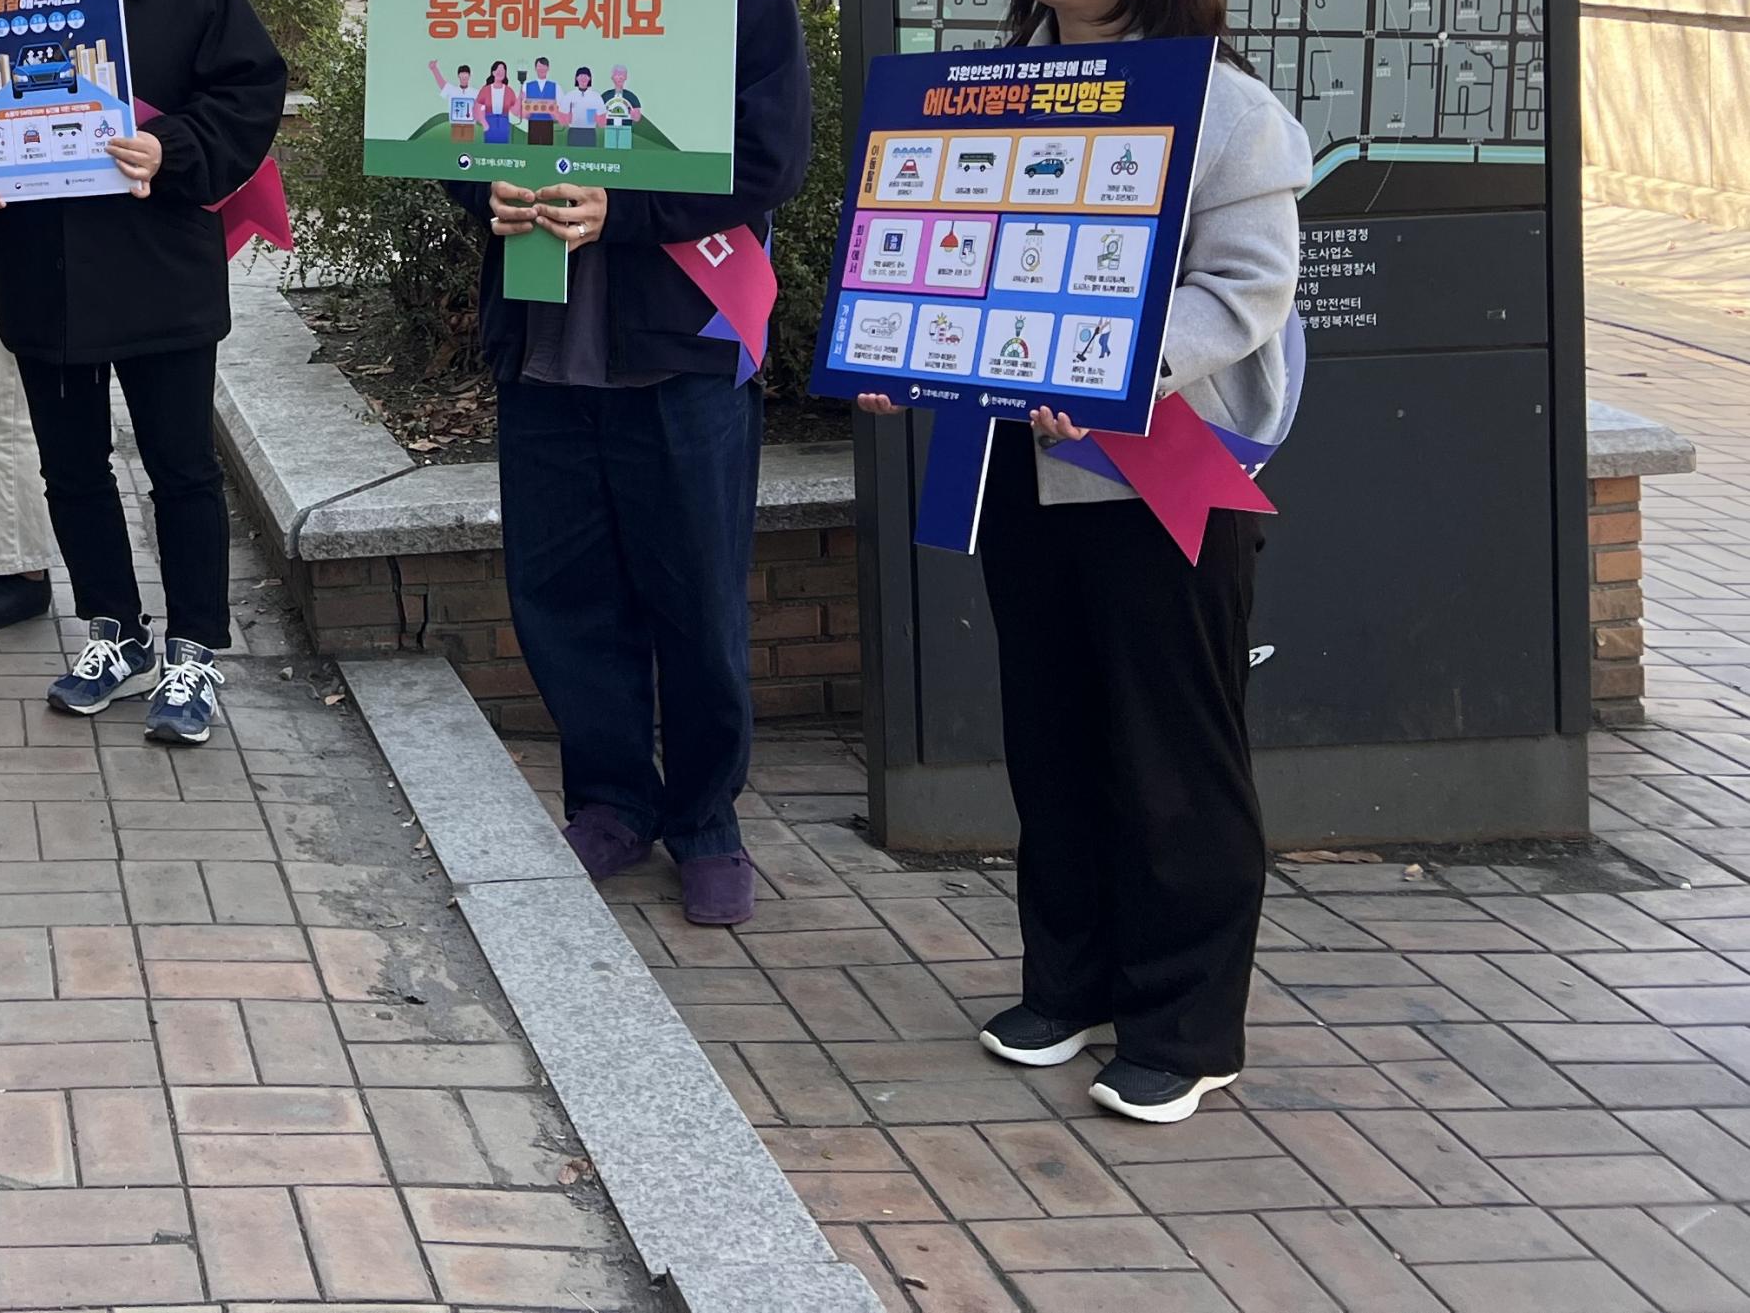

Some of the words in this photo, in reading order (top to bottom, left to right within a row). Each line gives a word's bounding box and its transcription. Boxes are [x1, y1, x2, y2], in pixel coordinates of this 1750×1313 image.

[947, 63, 1015, 81] 자원안보위기
[1017, 63, 1041, 79] 경보
[1044, 60, 1079, 77] 발령에
[1082, 59, 1107, 76] 따른
[922, 85, 1030, 116] 에너지절약
[1031, 80, 1126, 114] 국민행동
[1312, 228, 1368, 243] 대기환경청
[1298, 262, 1376, 278] 안산단원경찰서
[1297, 281, 1319, 295] 시청
[1316, 297, 1361, 311] 안전센터
